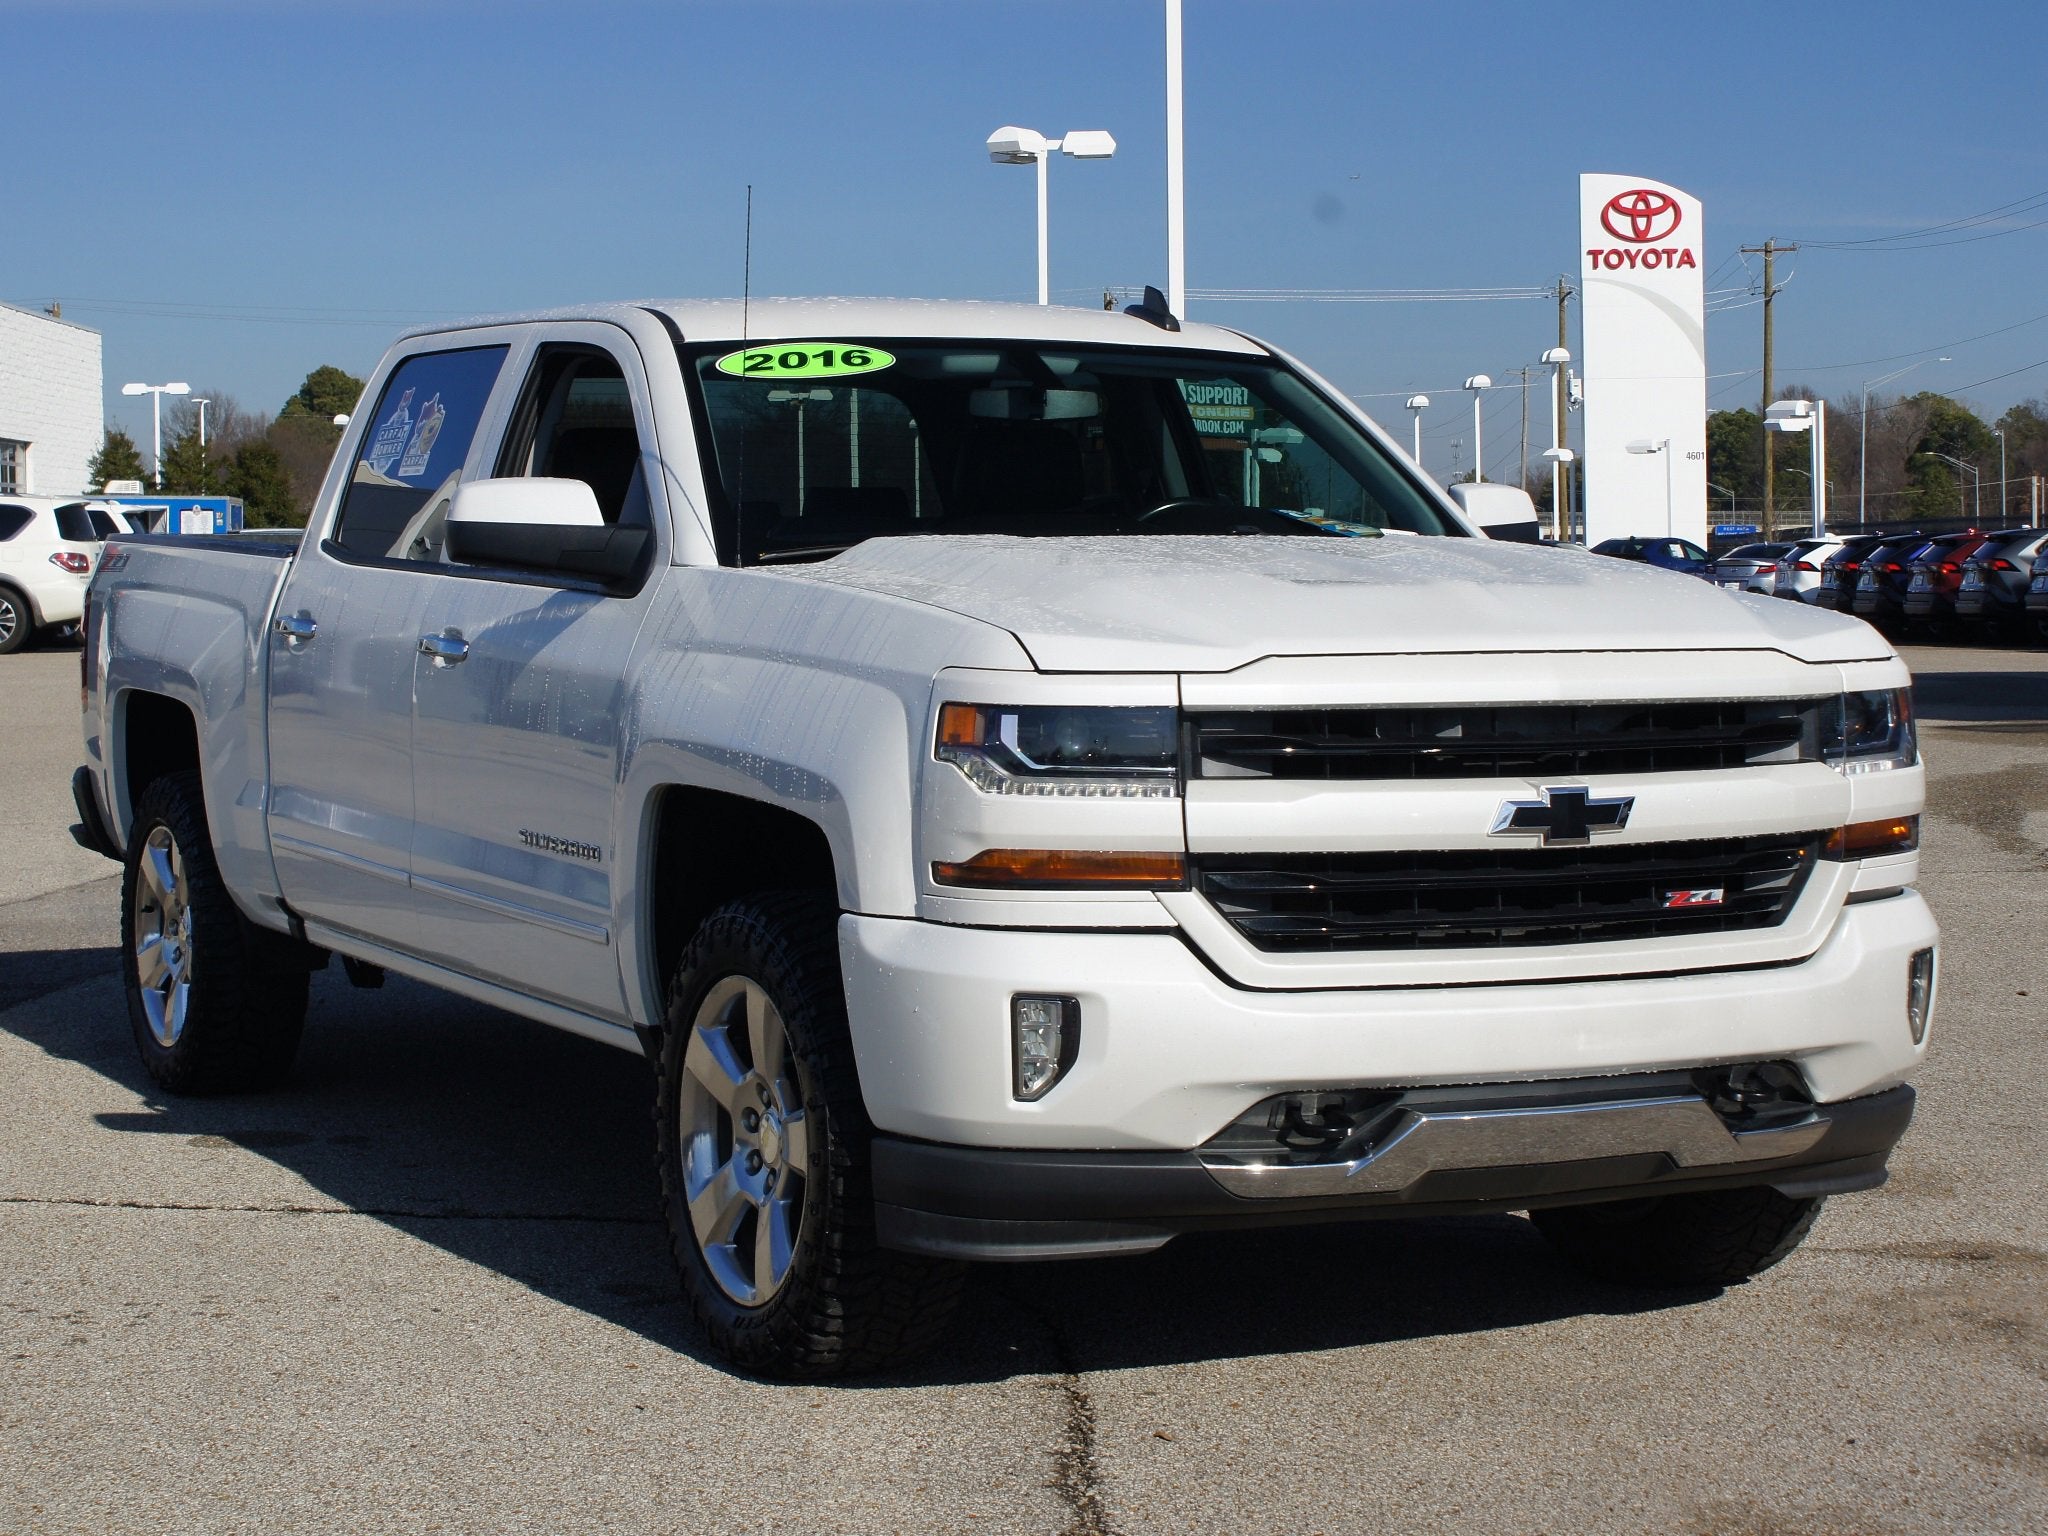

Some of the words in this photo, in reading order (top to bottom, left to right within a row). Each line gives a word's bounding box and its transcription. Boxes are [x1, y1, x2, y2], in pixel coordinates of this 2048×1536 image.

[1586, 248, 1697, 271] TOYOTA
[744, 350, 873, 372] 2016
[1187, 384, 1249, 405] SUPPORT
[1196, 407, 1250, 418] ONLINE
[1686, 451, 1705, 461] 4601
[518, 828, 602, 862] SILVERADO
[1662, 888, 1724, 908] Z71
